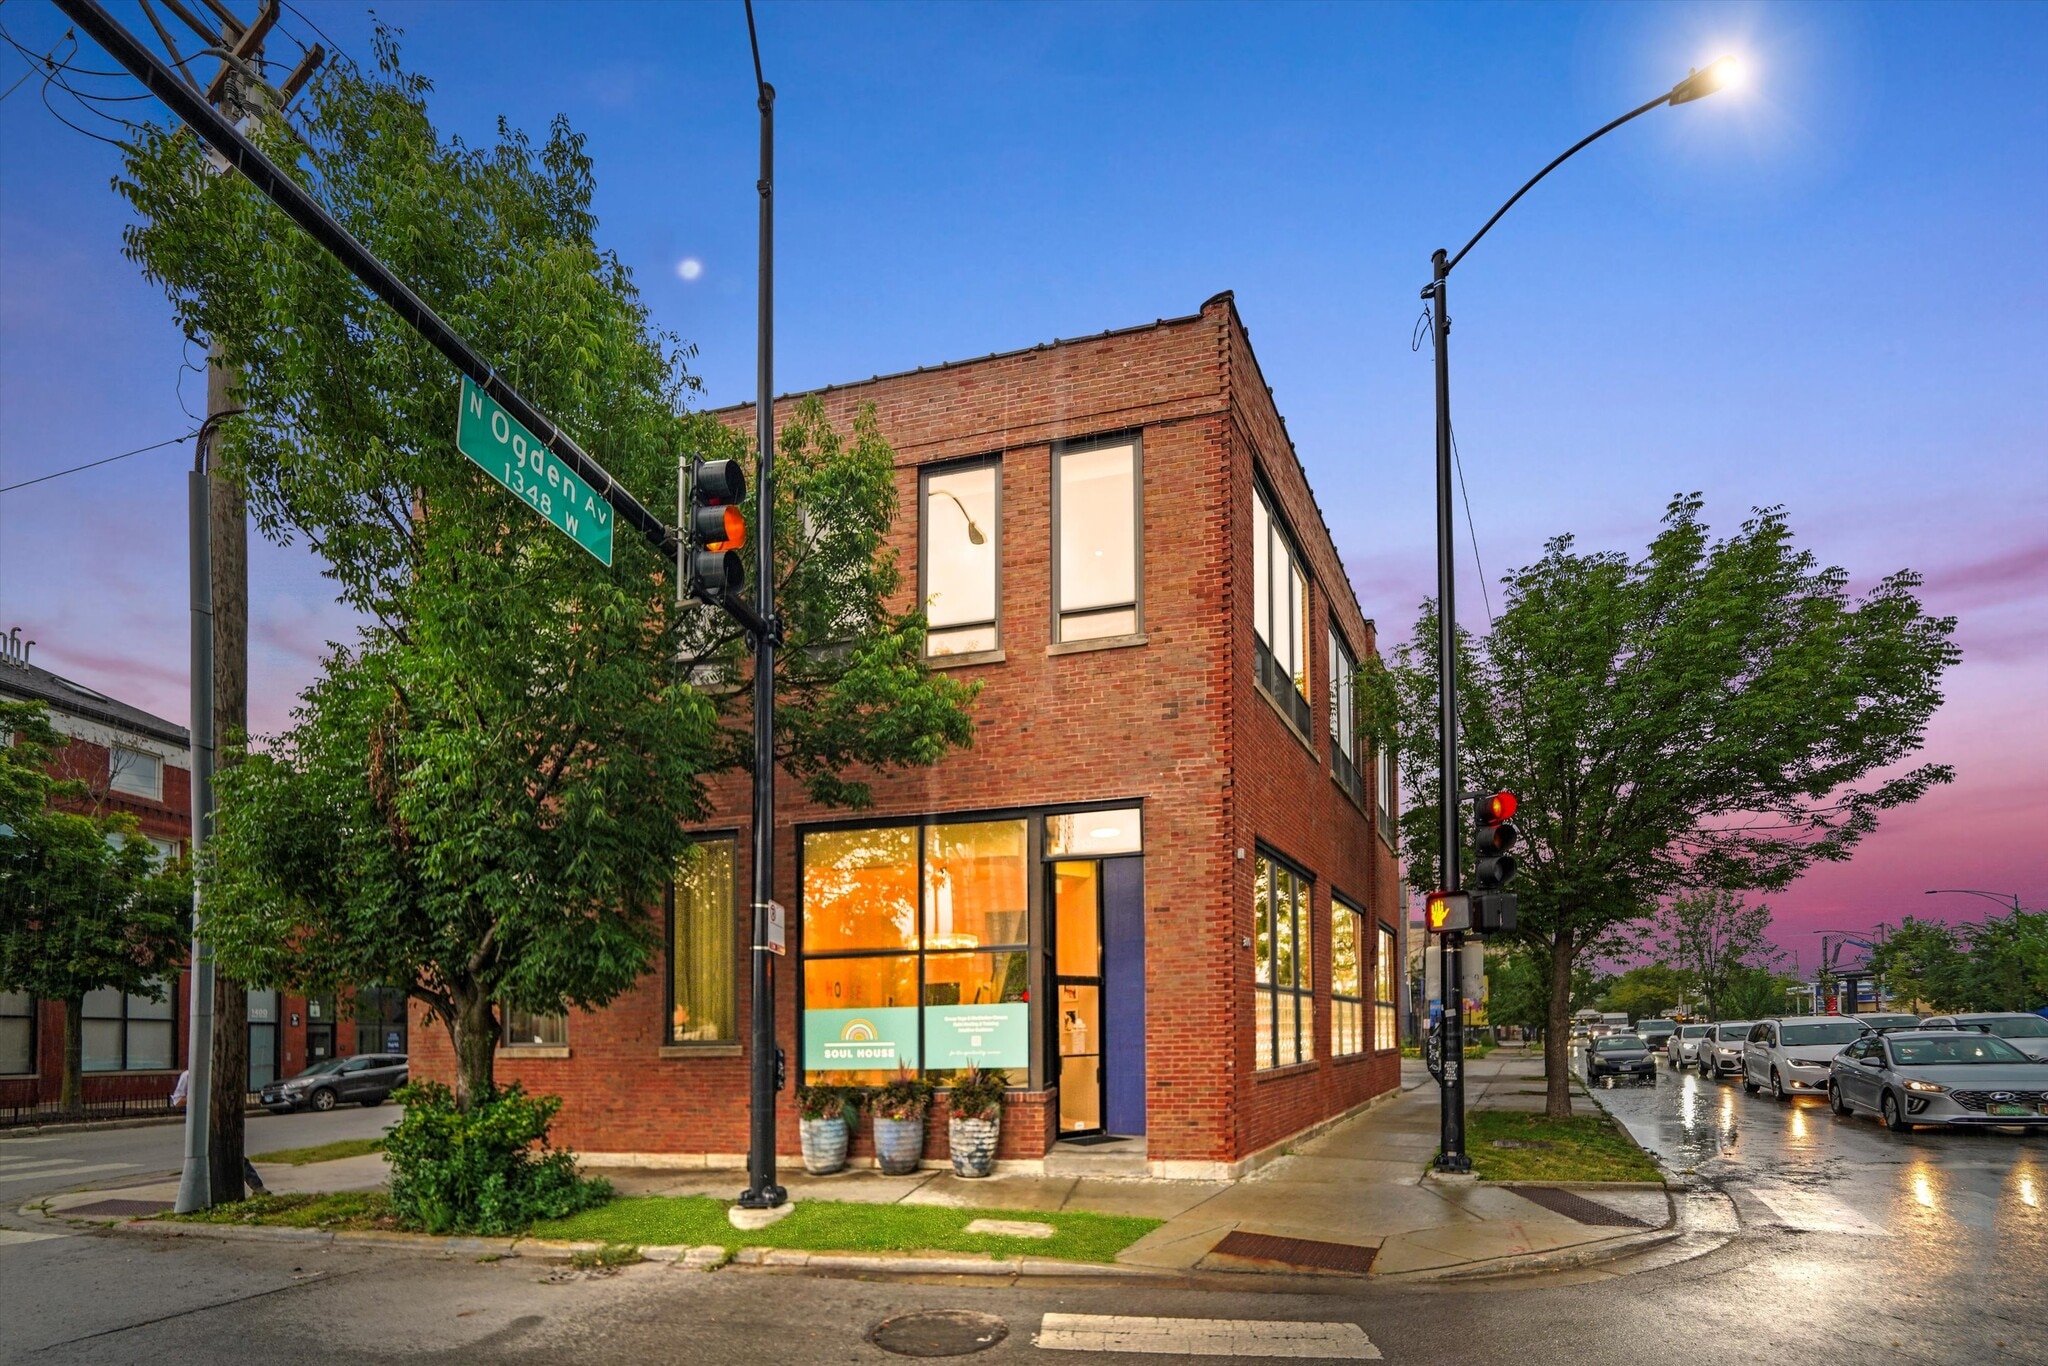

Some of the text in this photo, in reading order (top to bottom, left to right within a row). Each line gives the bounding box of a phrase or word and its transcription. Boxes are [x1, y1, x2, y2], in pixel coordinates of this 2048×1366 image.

[470, 391, 607, 525] N Ogden Av
[504, 462, 579, 537] 1348 W
[824, 1048, 895, 1059] SOUL HOUSE
